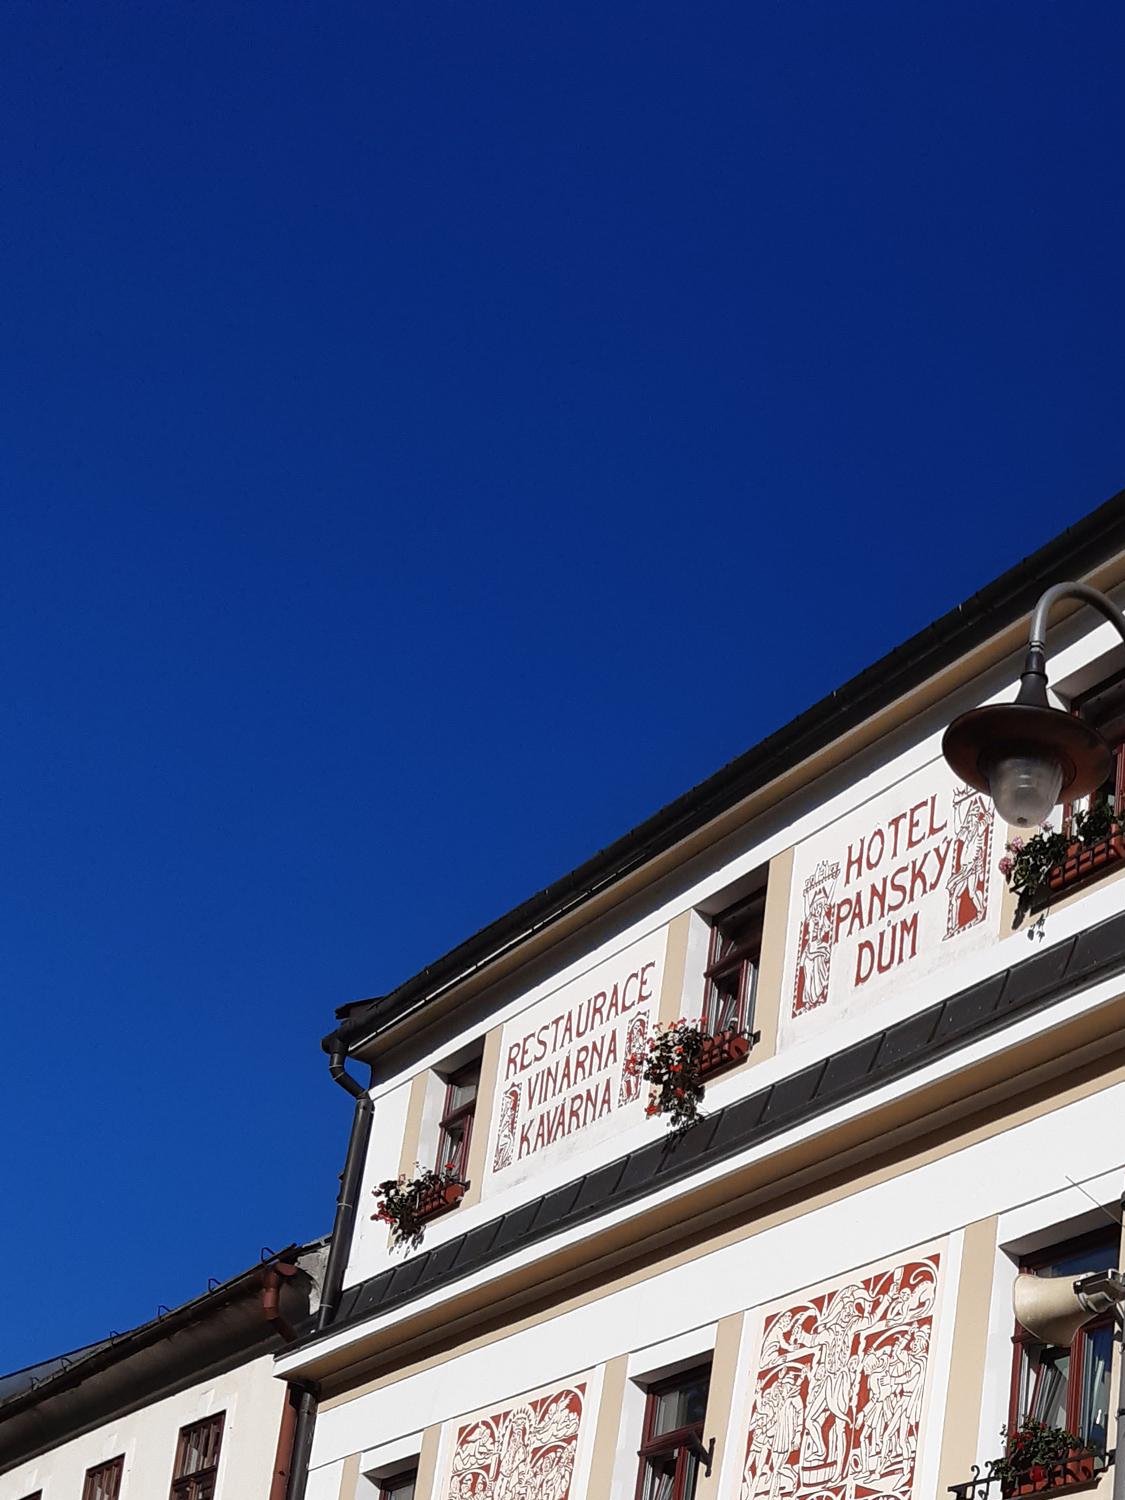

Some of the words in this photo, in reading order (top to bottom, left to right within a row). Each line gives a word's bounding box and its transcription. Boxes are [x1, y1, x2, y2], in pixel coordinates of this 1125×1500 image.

[843, 793, 948, 887] HOTEL
[833, 836, 953, 944] PANSKÝ
[854, 911, 919, 987] DŮM
[504, 960, 656, 1081] RESTAURACE
[527, 1027, 618, 1111] VINÁRNA
[517, 1077, 612, 1160] KAVÁRNA
